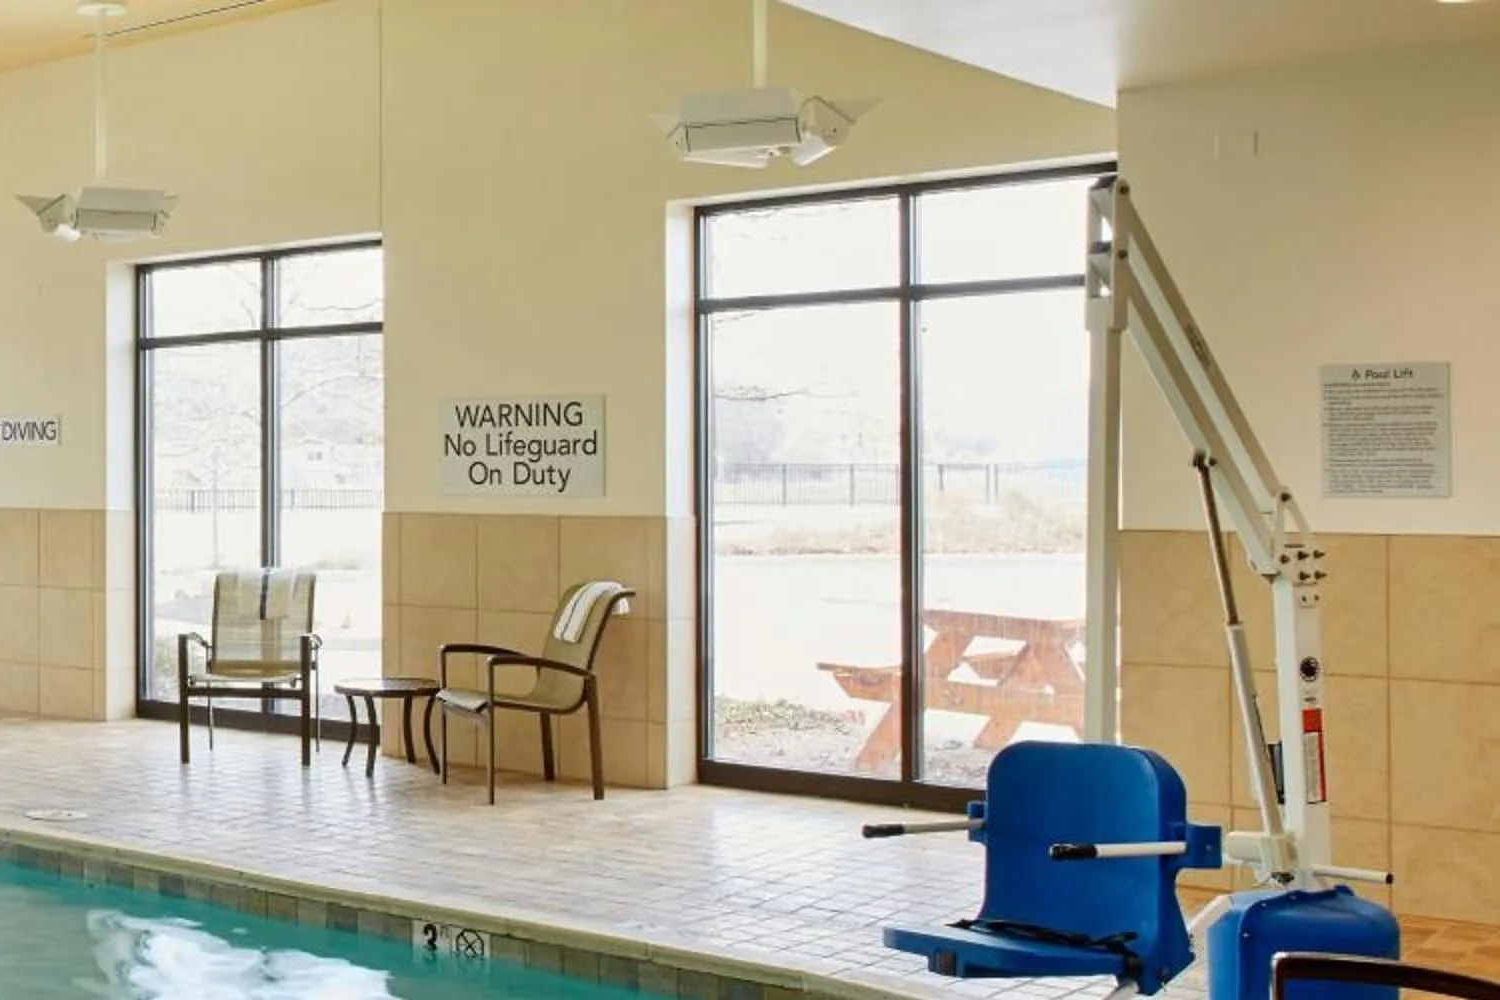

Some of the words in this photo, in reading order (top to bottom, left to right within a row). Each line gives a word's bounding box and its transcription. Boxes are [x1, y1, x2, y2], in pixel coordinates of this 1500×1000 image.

[455, 401, 583, 428] WARNING
[2, 420, 57, 441] DIVING
[443, 433, 477, 456] No
[485, 429, 598, 463] Lifeguard
[468, 461, 502, 485] On
[513, 461, 571, 493] Duty
